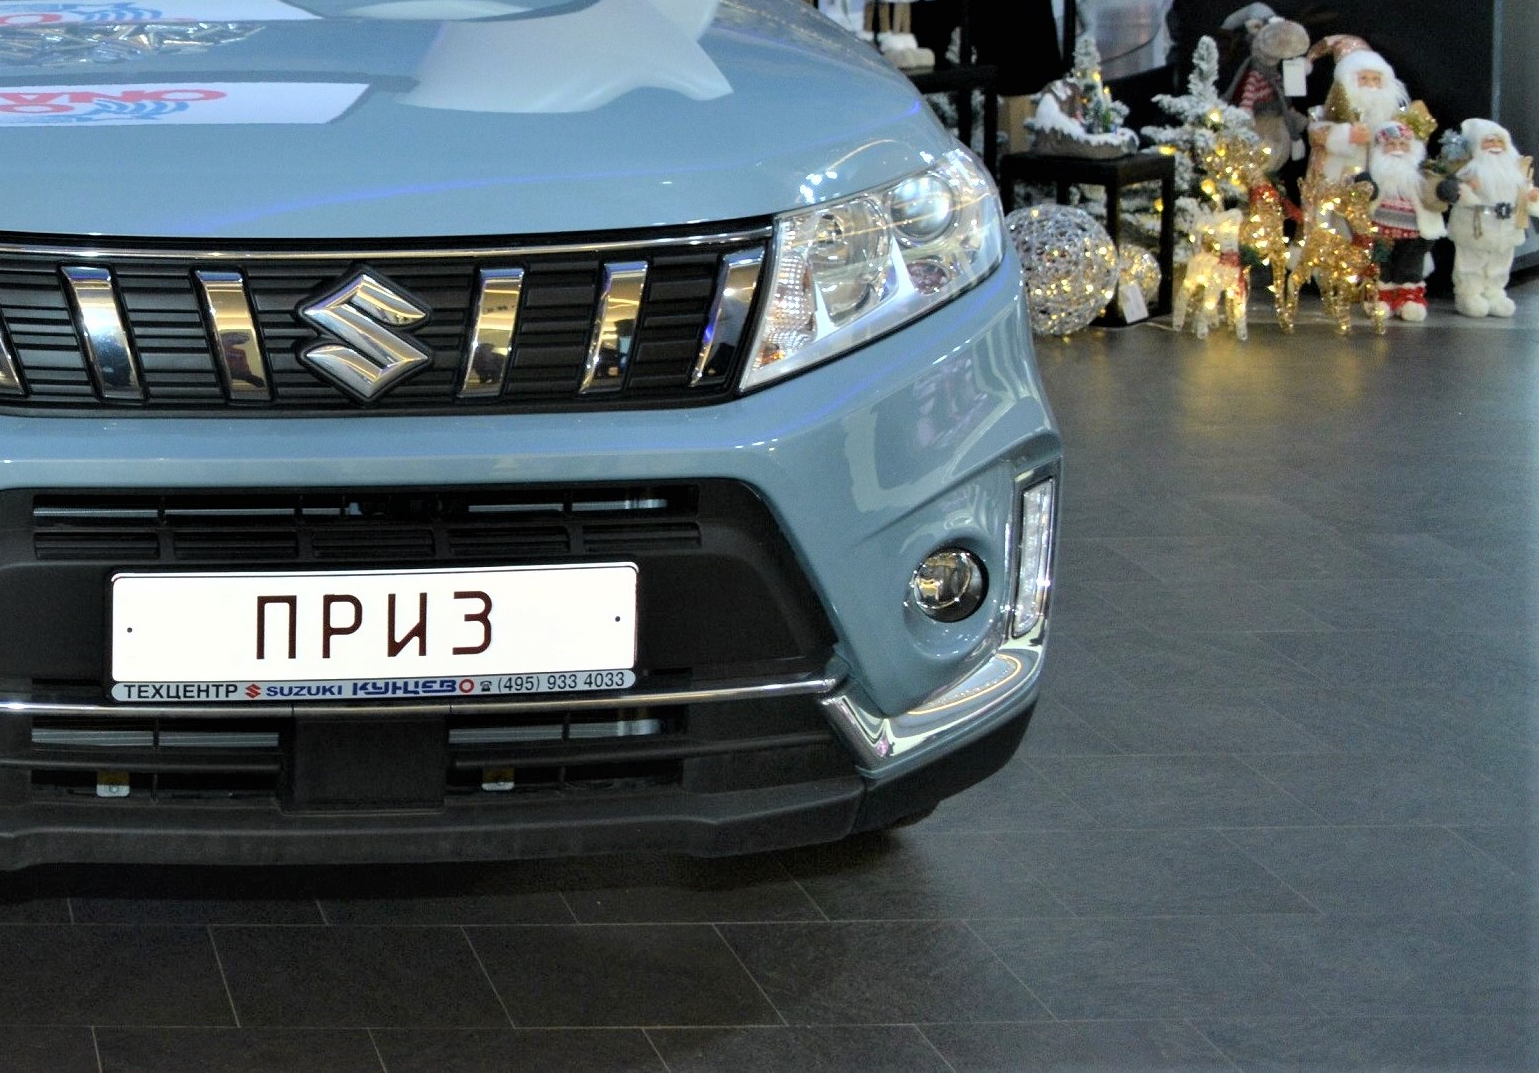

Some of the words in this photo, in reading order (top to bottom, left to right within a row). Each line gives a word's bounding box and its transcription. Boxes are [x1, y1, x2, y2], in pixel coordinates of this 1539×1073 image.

[256, 590, 493, 660] ПРИЗ
[123, 683, 239, 700] ТЕХЦЕНТР
[265, 684, 343, 697] SUZUKI
[497, 675, 541, 693] (495)
[547, 673, 578, 690] 933
[583, 671, 626, 689] 4033
